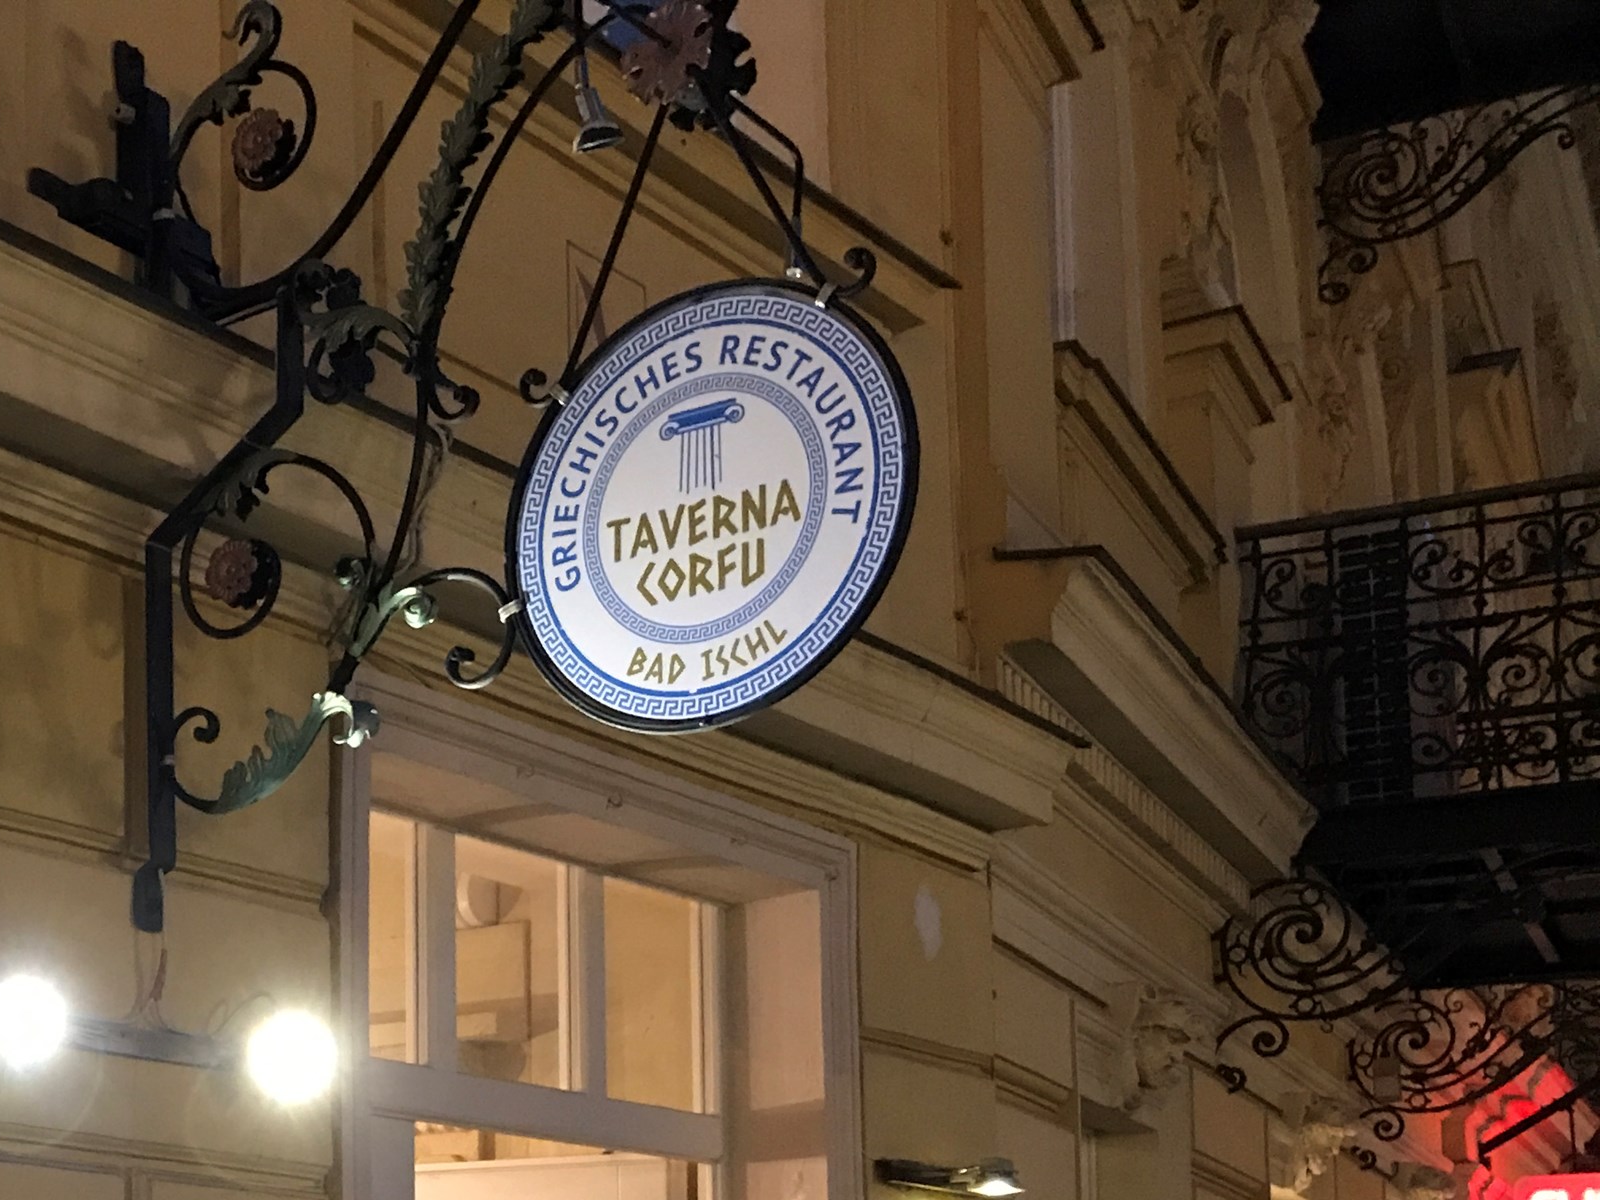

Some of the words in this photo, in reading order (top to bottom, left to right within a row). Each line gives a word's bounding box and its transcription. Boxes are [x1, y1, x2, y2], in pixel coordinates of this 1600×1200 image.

[554, 341, 703, 592] GRIECHISCHES
[719, 335, 864, 523] RESTAURANT
[607, 479, 801, 563] TAVERNA
[636, 538, 765, 606] CORFU
[627, 647, 686, 685] BAD
[702, 619, 788, 681] ISCHL
